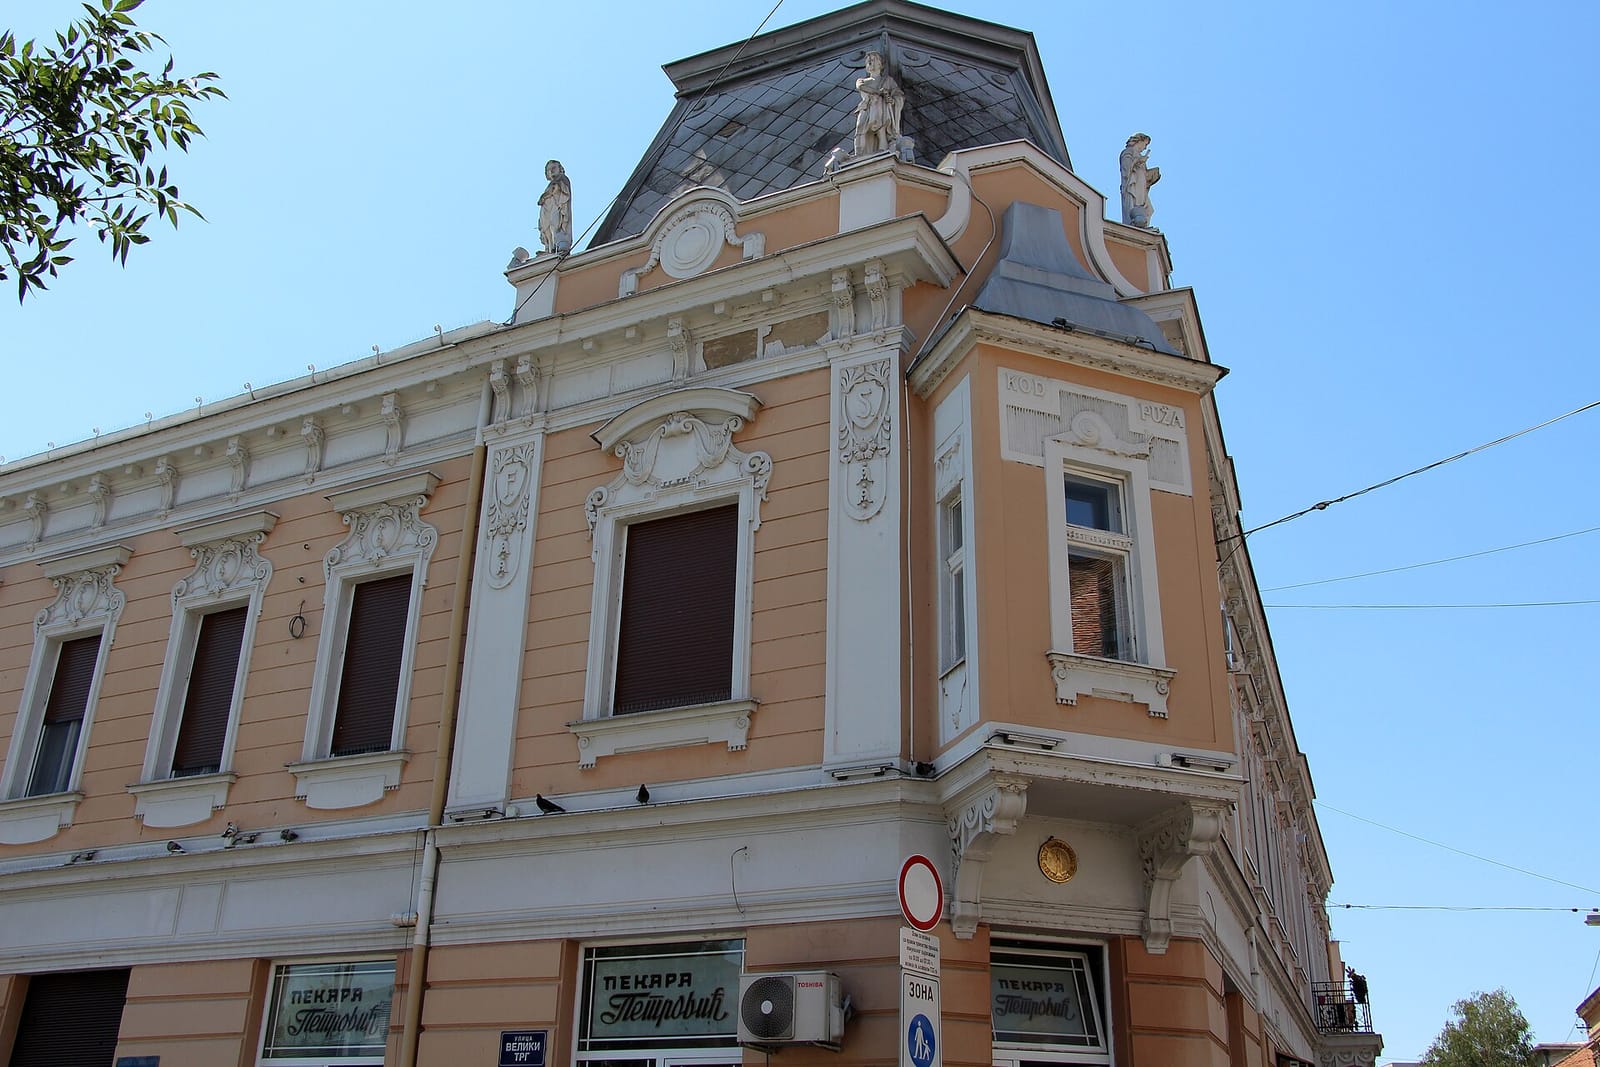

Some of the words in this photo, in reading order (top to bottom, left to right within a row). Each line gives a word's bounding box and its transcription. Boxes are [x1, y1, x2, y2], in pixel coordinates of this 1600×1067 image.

[1005, 373, 1046, 397] KOD
[1139, 402, 1184, 428] PUŽA
[603, 972, 692, 990] ПЕКАРА
[998, 979, 1065, 992] ПЕКАРА
[291, 987, 362, 1004] ПЕКАРА
[909, 982, 934, 1001] ЗОНА
[600, 987, 729, 1027] Петровић
[505, 1041, 540, 1051] ВЕЛИКИ
[514, 1052, 530, 1061] ТРГ
